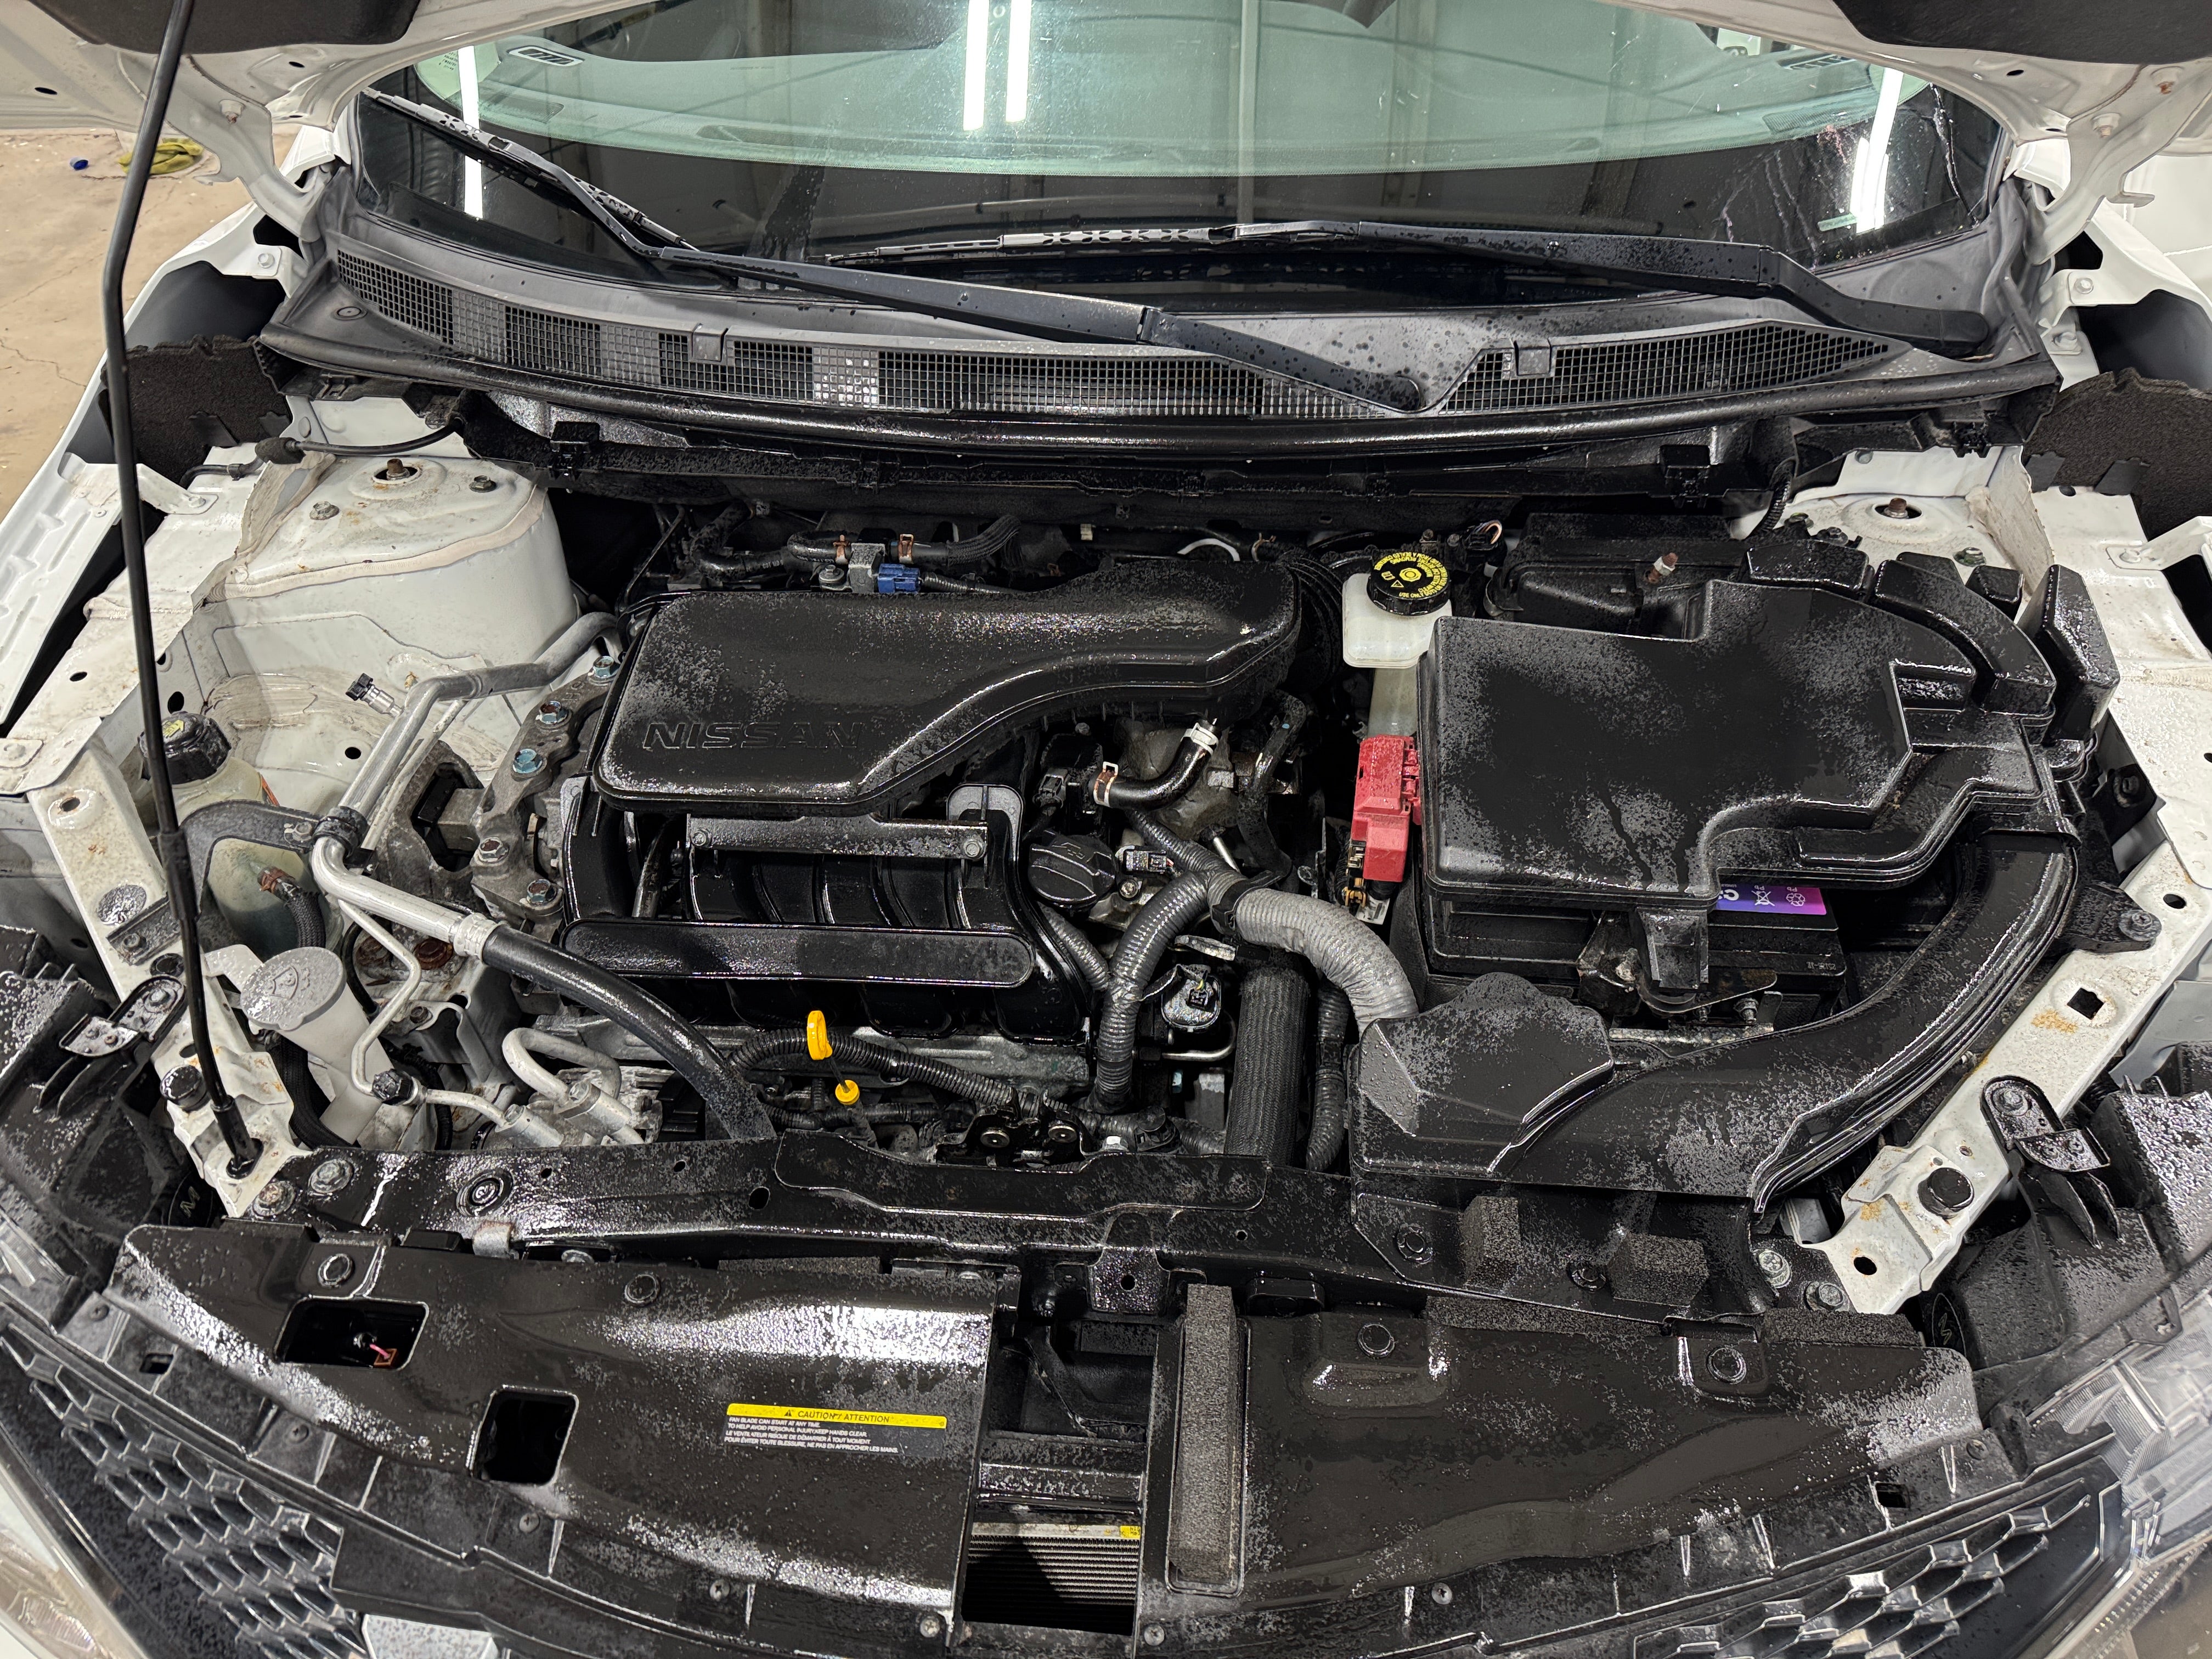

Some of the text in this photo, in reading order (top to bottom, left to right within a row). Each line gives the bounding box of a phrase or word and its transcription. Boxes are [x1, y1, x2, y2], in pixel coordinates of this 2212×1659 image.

[642, 721, 864, 750] NISSAN
[798, 1410, 837, 1420] CAUTION
[843, 1414, 890, 1423] ATTENTION
